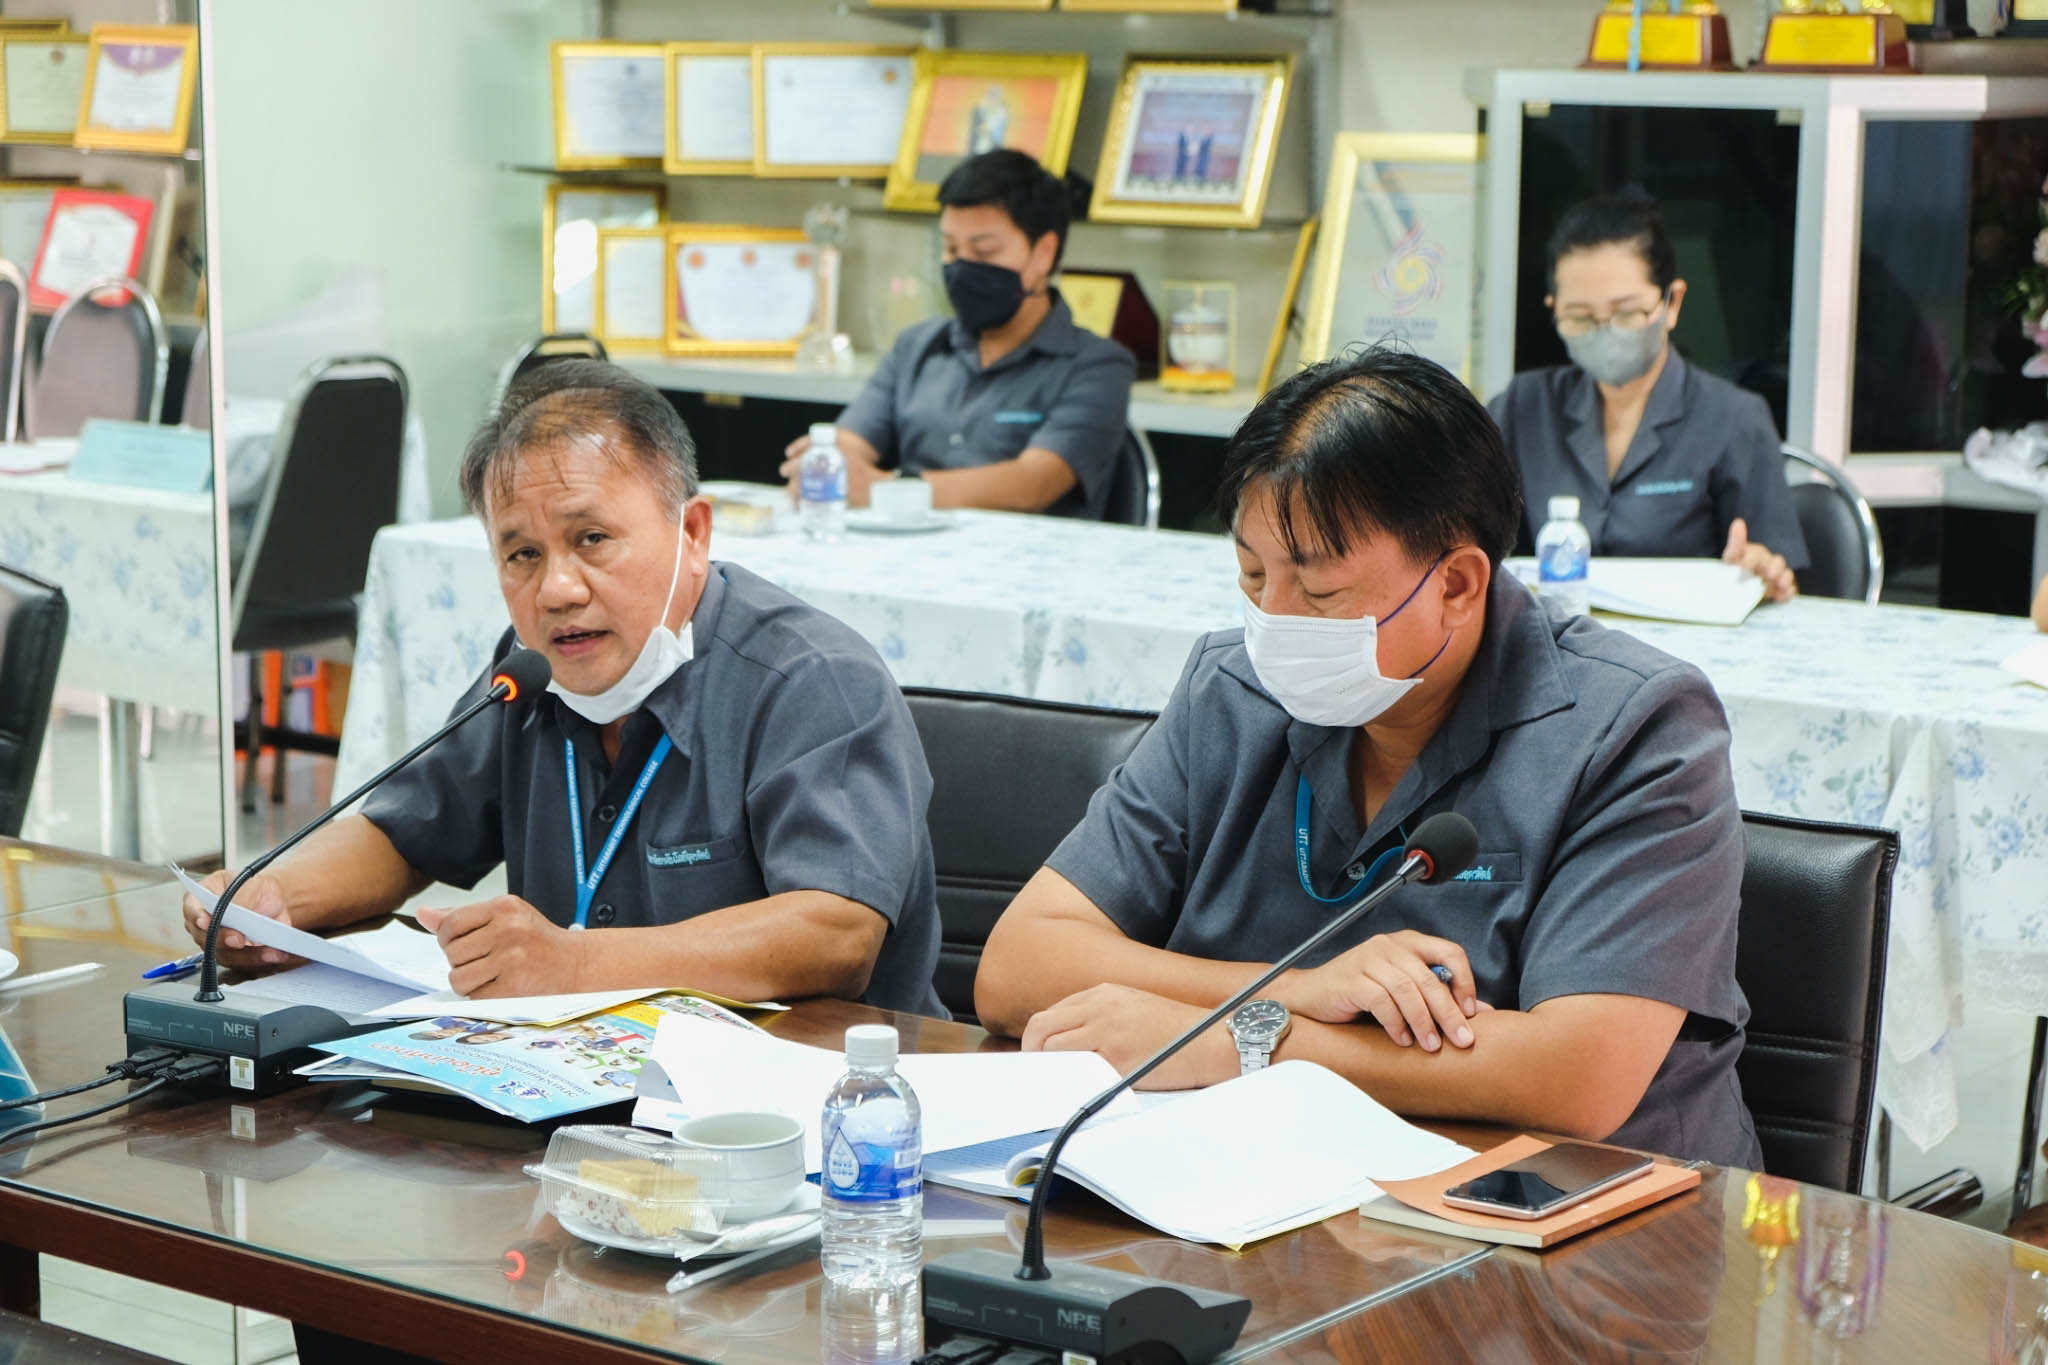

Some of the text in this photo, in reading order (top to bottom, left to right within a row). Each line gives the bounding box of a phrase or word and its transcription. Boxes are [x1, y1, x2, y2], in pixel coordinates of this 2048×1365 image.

[587, 760, 659, 890] UTT UTTARADIT TECHNOLOGICAL COLLEGE
[1298, 828, 1309, 846] UTT
[223, 1022, 256, 1037] NPE
[1057, 1306, 1102, 1330] NPE
